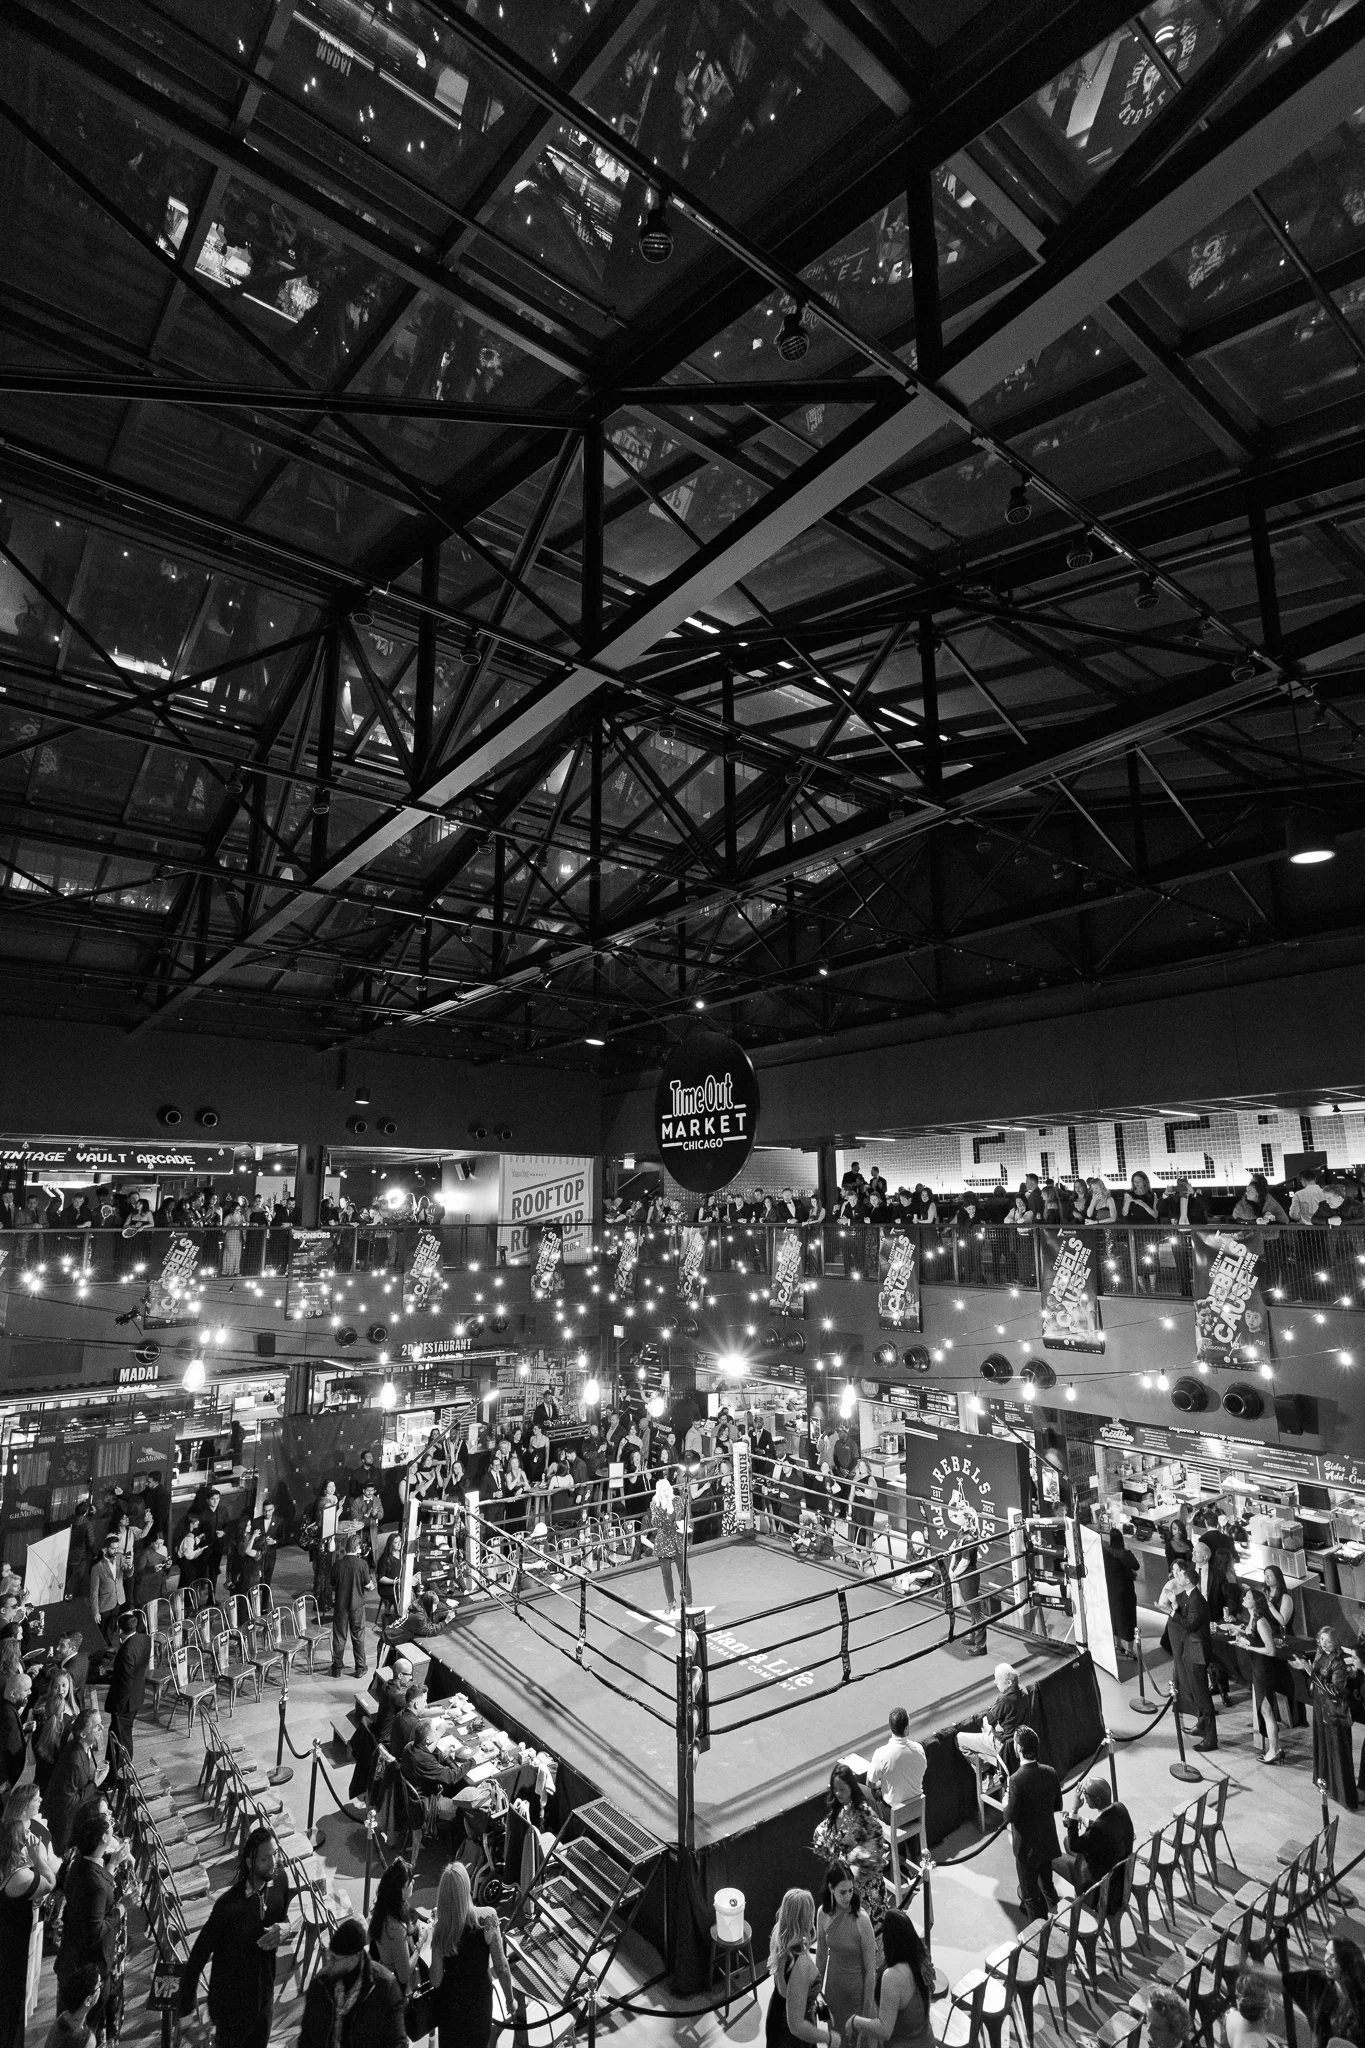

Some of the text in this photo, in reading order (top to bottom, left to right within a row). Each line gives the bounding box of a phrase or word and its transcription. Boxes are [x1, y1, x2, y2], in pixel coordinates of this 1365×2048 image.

[662, 1113, 747, 1140] MARKET
[682, 1138, 723, 1151] CHICAGO
[76, 1153, 127, 1164] VAULT
[136, 1154, 196, 1165] ARCADE
[512, 1179, 584, 1221] ROOFTOP
[410, 1233, 436, 1279] REBELS
[1049, 1237, 1083, 1302] REBELS
[777, 1256, 802, 1303] CAUSE
[887, 1260, 915, 1313] CAUSE
[1206, 1240, 1247, 1314] REBELS
[1056, 1267, 1092, 1328] CAUSE
[1213, 1269, 1259, 1343] CAUSE
[401, 1344, 413, 1356] 2D
[119, 1366, 159, 1383] MADAI
[739, 1453, 750, 1511] RINGSIDE
[932, 1456, 991, 1495] REBELS
[1323, 1460, 1346, 1472] Sides
[932, 1490, 941, 1499] EST
[982, 1504, 994, 1514] 2024
[155, 1982, 180, 1998] VIP
